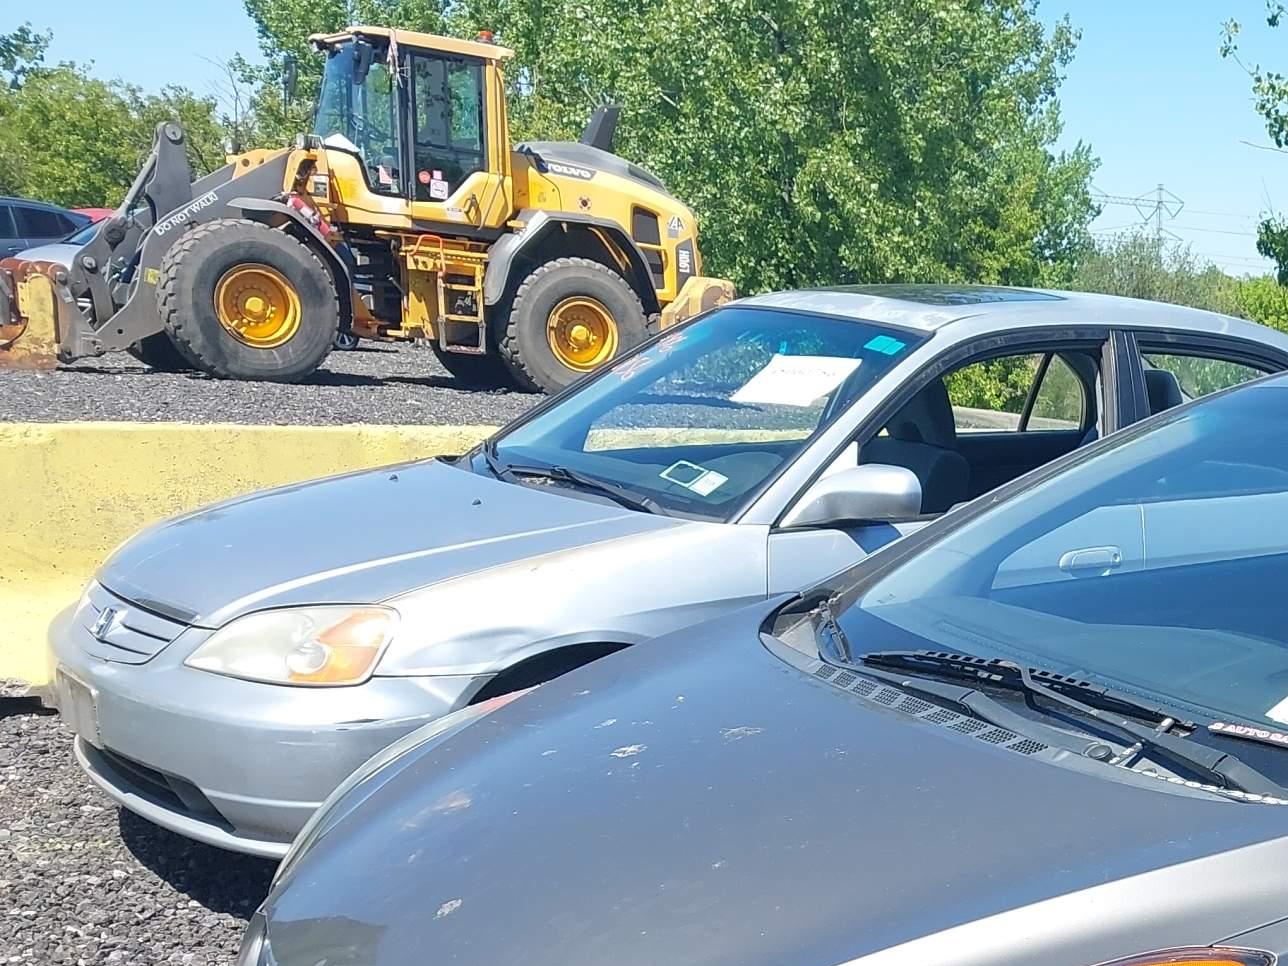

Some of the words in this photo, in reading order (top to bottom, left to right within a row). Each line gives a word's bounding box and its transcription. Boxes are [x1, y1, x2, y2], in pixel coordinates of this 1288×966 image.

[153, 222, 172, 236] DO
[171, 209, 191, 226] NOT
[190, 191, 219, 213] WALK
[1223, 724, 1270, 739] AUTO
